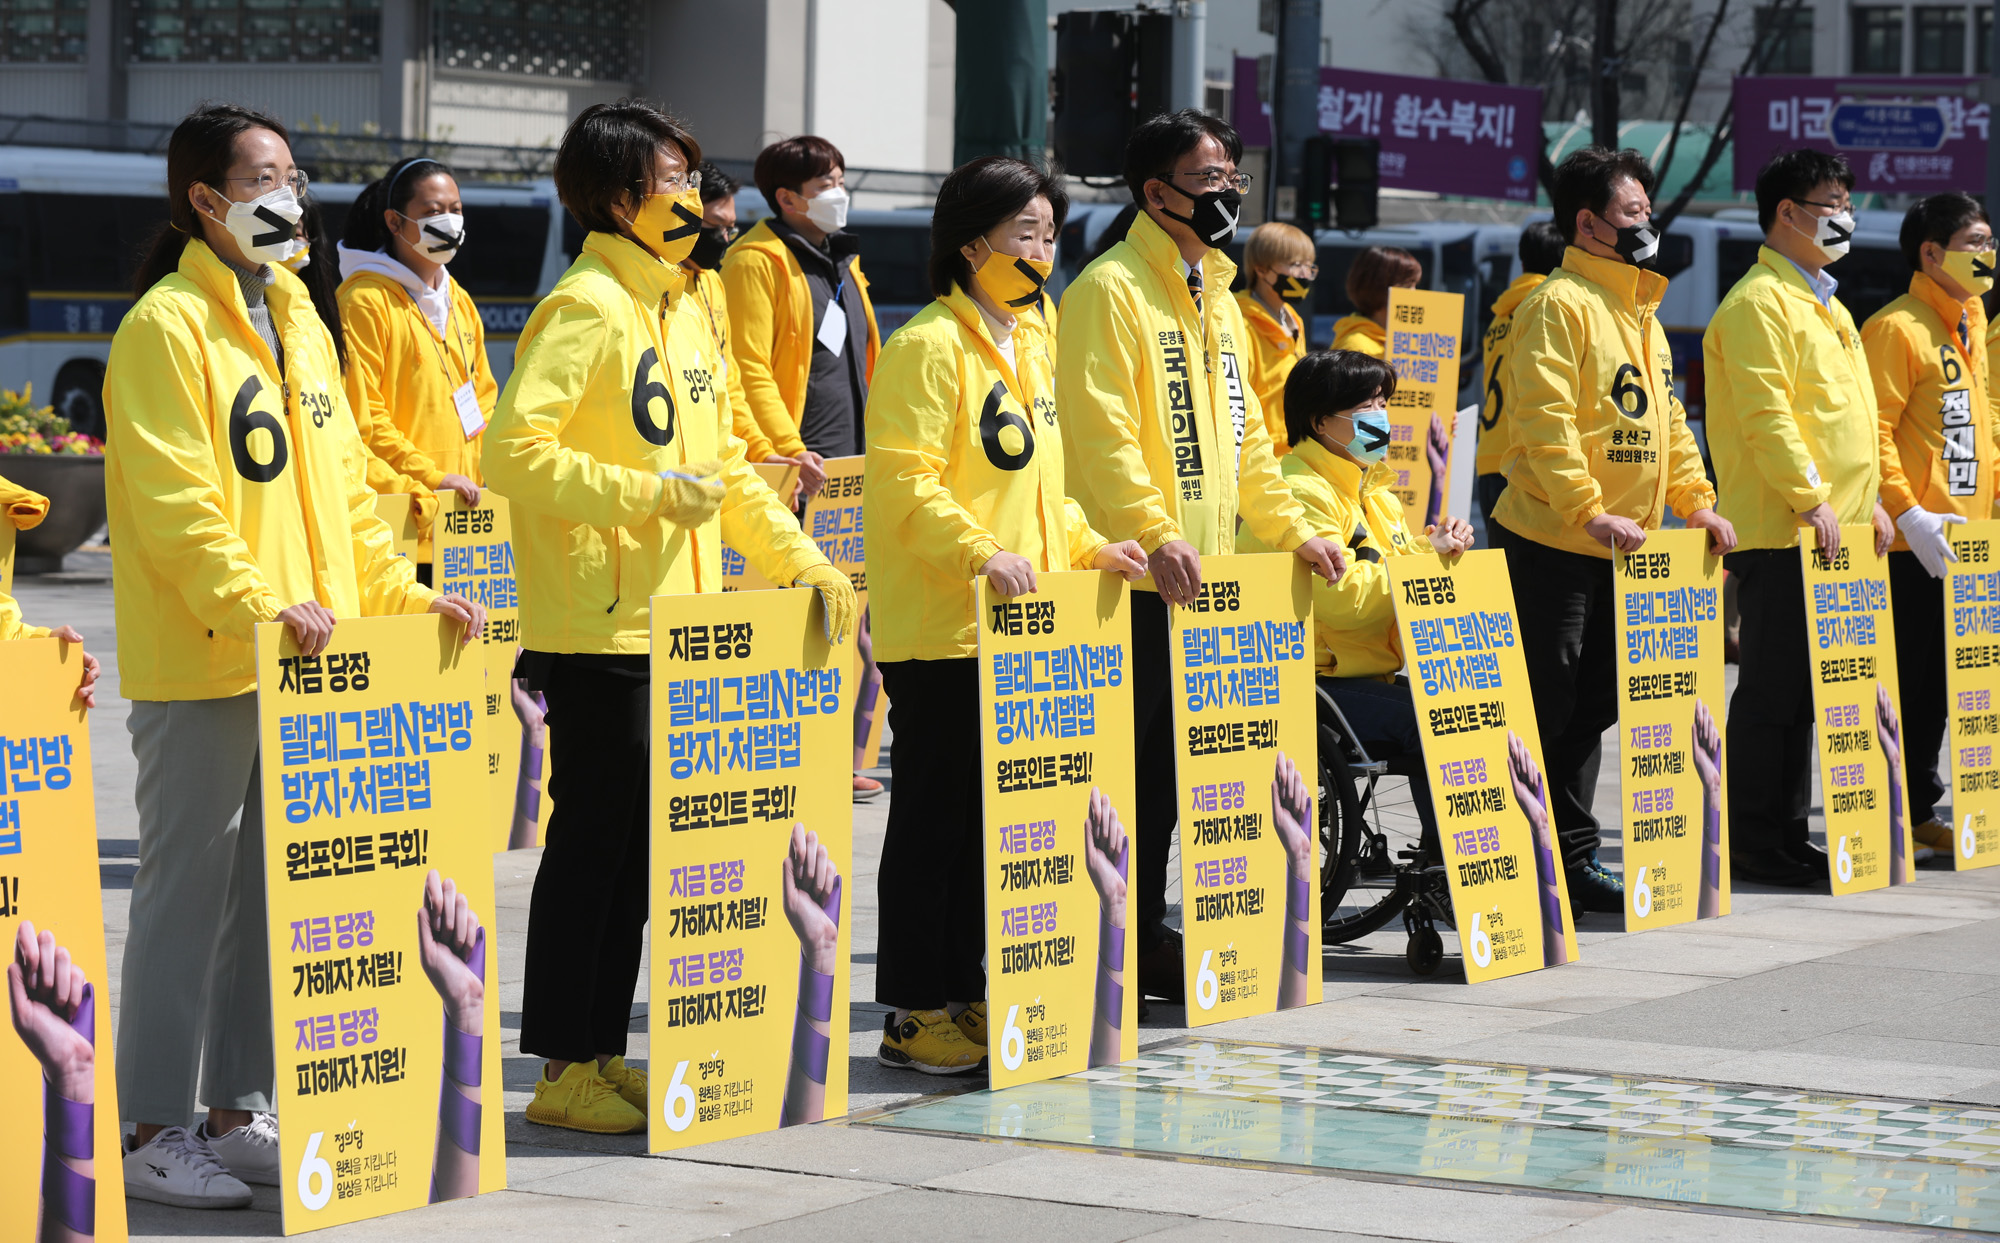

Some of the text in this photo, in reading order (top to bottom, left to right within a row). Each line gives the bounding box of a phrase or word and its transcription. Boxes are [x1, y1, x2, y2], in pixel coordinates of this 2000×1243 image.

[1318, 86, 1515, 148] 철거! 환수복지!
[1940, 344, 1960, 385] 6
[632, 346, 674, 446] 6
[1482, 354, 1504, 432] 6
[1611, 363, 1648, 419] 6
[230, 375, 287, 482] 6
[979, 380, 1034, 470] 6
[1164, 347, 1203, 477] 국회의원
[1607, 450, 1656, 463] 국회의원후보
[1612, 430, 1651, 446] 용산구
[1938, 389, 1978, 496] 정재민
[1181, 480, 1200, 490] 예비
[1183, 490, 1202, 501] 후보
[444, 509, 494, 534] 지금 당장
[1624, 553, 1670, 579] 지금 당장
[1212, 581, 1240, 612] 당장
[1402, 576, 1456, 606] 지금 당장
[1625, 587, 1717, 626] 텔레그램N번방
[1814, 579, 1887, 614] 텔레그램N번방
[992, 600, 1055, 636] 지금 당장
[1410, 611, 1514, 656] 텔레그램N번방
[1816, 615, 1876, 649] 방지·처벌법
[669, 622, 753, 661] 지금 당장
[1183, 620, 1305, 667] 텔레그램N번방
[1626, 625, 1698, 664] 방지·처벌법
[278, 651, 370, 695] 지금 당장
[993, 644, 1123, 696] 텔레그램N번방
[1418, 652, 1502, 696] 방지·처벌법
[1628, 671, 1697, 701] 원포인트 국회!
[1821, 656, 1876, 683] 원포인트 국회!
[669, 668, 841, 727] 텔레그램N번방
[1184, 666, 1280, 712] 방지·처벌법
[1958, 689, 1990, 711] 지금 당장
[280, 701, 473, 766] 텔레그램N번방
[994, 693, 1095, 745] 방지·처벌법
[1429, 701, 1506, 736] 원포인트 국회!
[1825, 704, 1860, 728] 지금 당장
[668, 722, 800, 779] 방지·처벌법
[1188, 719, 1278, 756] 원포인트 국회!
[1631, 723, 1672, 749] 지금 당장
[1827, 730, 1871, 754] 가해자 처벌!
[997, 752, 1093, 793] 원포인트 국회!
[1440, 758, 1488, 787] 지금 당장
[1632, 751, 1685, 778] 가해자 처벌!
[1830, 763, 1865, 787] 지금 당장
[1960, 745, 1992, 768] 지금 당장
[282, 760, 431, 823] 방지·처벌법
[669, 785, 796, 832] 원포인트 국회!
[1192, 781, 1245, 812] 지금 당장
[1446, 786, 1506, 818] 가해자 처벌!
[1633, 787, 1674, 814] 지금 당장
[1832, 789, 1876, 814] 피해자 지원!
[999, 820, 1056, 854] 지금 당장
[1193, 813, 1262, 846] 가해자 처벌!
[1452, 826, 1500, 856] 지금 당장
[1633, 815, 1687, 843] 피해자 지원!
[1961, 814, 1975, 859] 6
[286, 829, 428, 881] 원포인트 국회!
[1000, 854, 1074, 892] 가해자 처벌!
[1194, 856, 1247, 888] 지금 당장
[1458, 855, 1519, 888] 피해자 지원!
[1836, 836, 1852, 883] 6
[669, 860, 744, 898] 지금 당장
[1633, 866, 1651, 918] 6
[669, 897, 768, 938] 가해자 처벌!
[1001, 901, 1057, 937] 지금 당장
[1196, 888, 1264, 922] 피해자 지원!
[290, 910, 374, 953] 지금 당장
[1470, 912, 1492, 968] 6
[668, 948, 744, 988] 지금 당장
[1001, 936, 1075, 974] 피해자 지원!
[1219, 950, 1237, 967] 정의당
[292, 951, 402, 998] 가해자 처벌!
[1196, 950, 1218, 1010] 6
[668, 985, 766, 1028] 피해자 지원!
[1026, 1004, 1045, 1023] 정의당
[295, 1007, 379, 1051] 지금 당장
[1000, 1005, 1025, 1071] 6
[296, 1048, 406, 1096] 피해자 지원!
[698, 1059, 724, 1080] 정의당
[664, 1060, 696, 1132] 6
[698, 1079, 753, 1102] 원칙을 지킵니다
[698, 1098, 753, 1122] 일상을 지킵니다
[334, 1129, 363, 1152] 정의당
[298, 1131, 333, 1211] 6
[336, 1150, 397, 1178] 원칙을 지킵니다
[337, 1171, 397, 1199] 일상을 지킵니다
